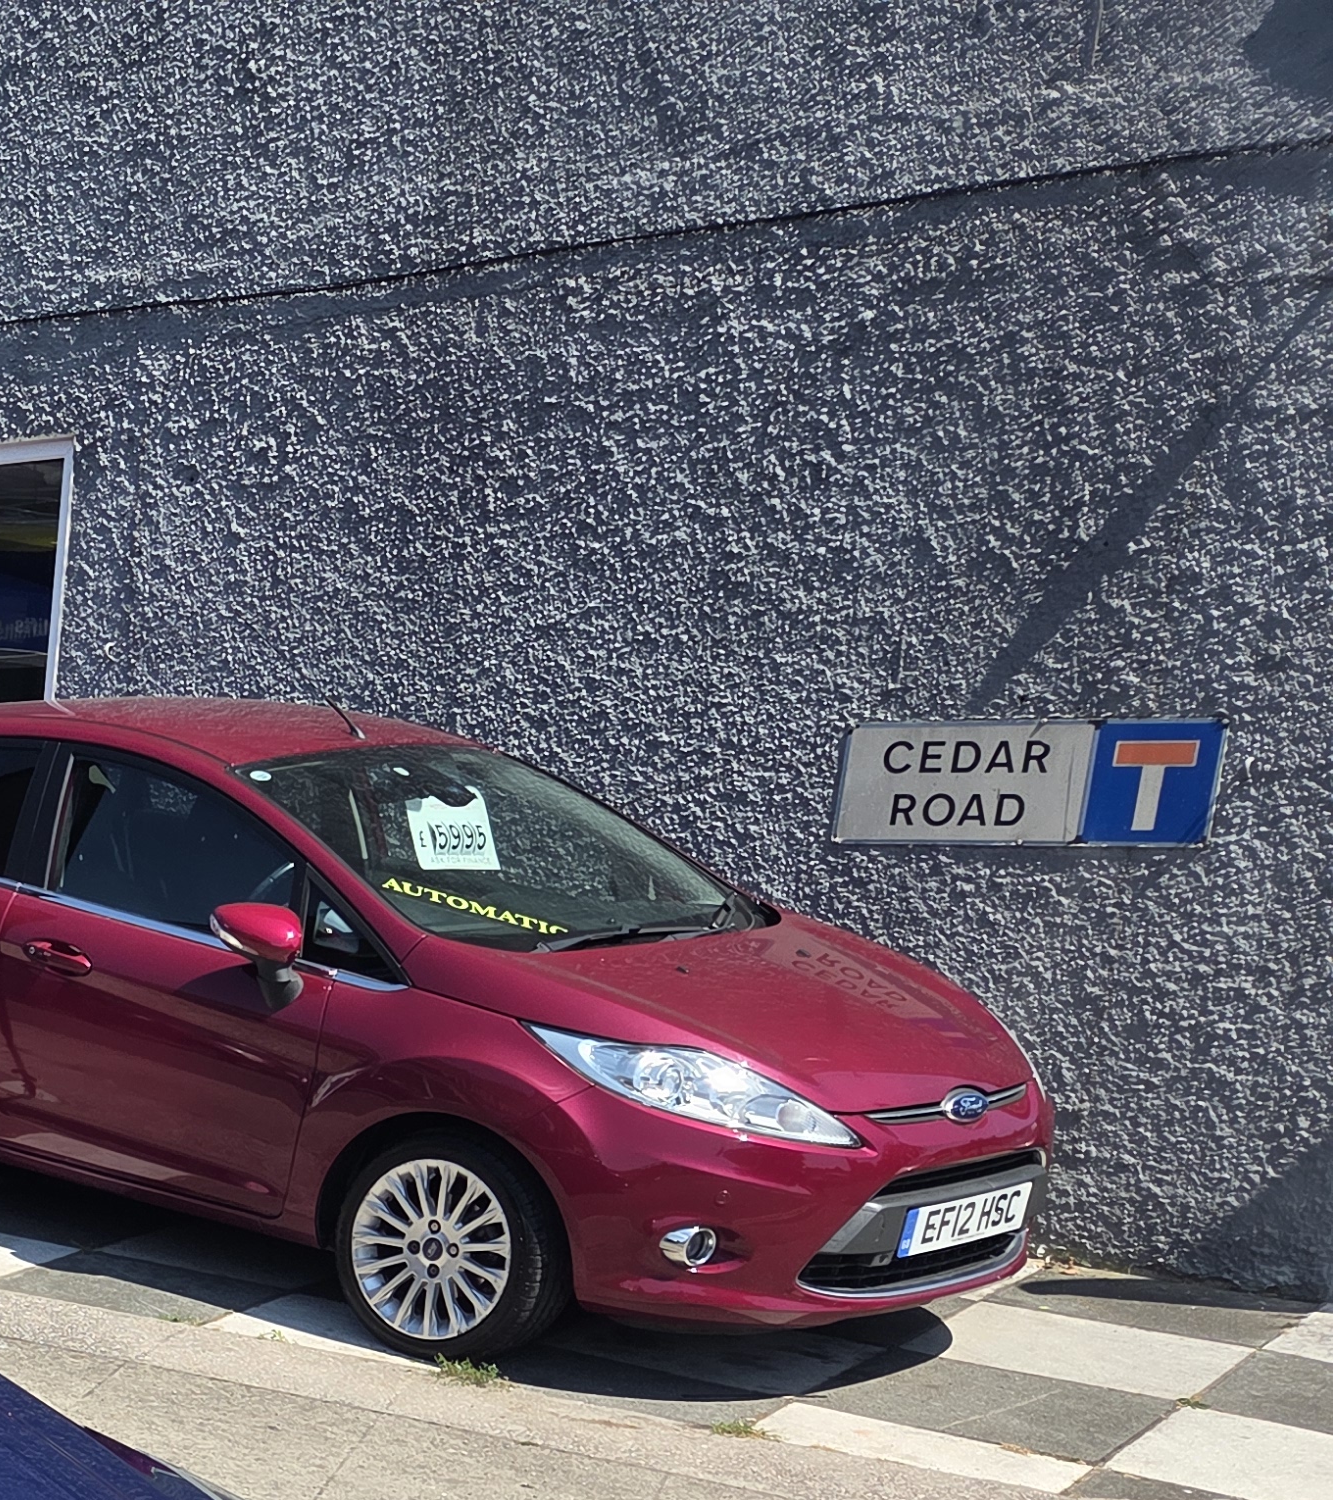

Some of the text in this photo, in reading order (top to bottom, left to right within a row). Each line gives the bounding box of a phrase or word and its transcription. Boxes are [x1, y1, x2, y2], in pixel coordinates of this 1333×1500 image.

[883, 740, 1051, 774] CEDAR
[889, 793, 1025, 827] ROAD
[434, 824, 487, 851] 5995
[921, 1189, 1022, 1244] EF12 HSC
